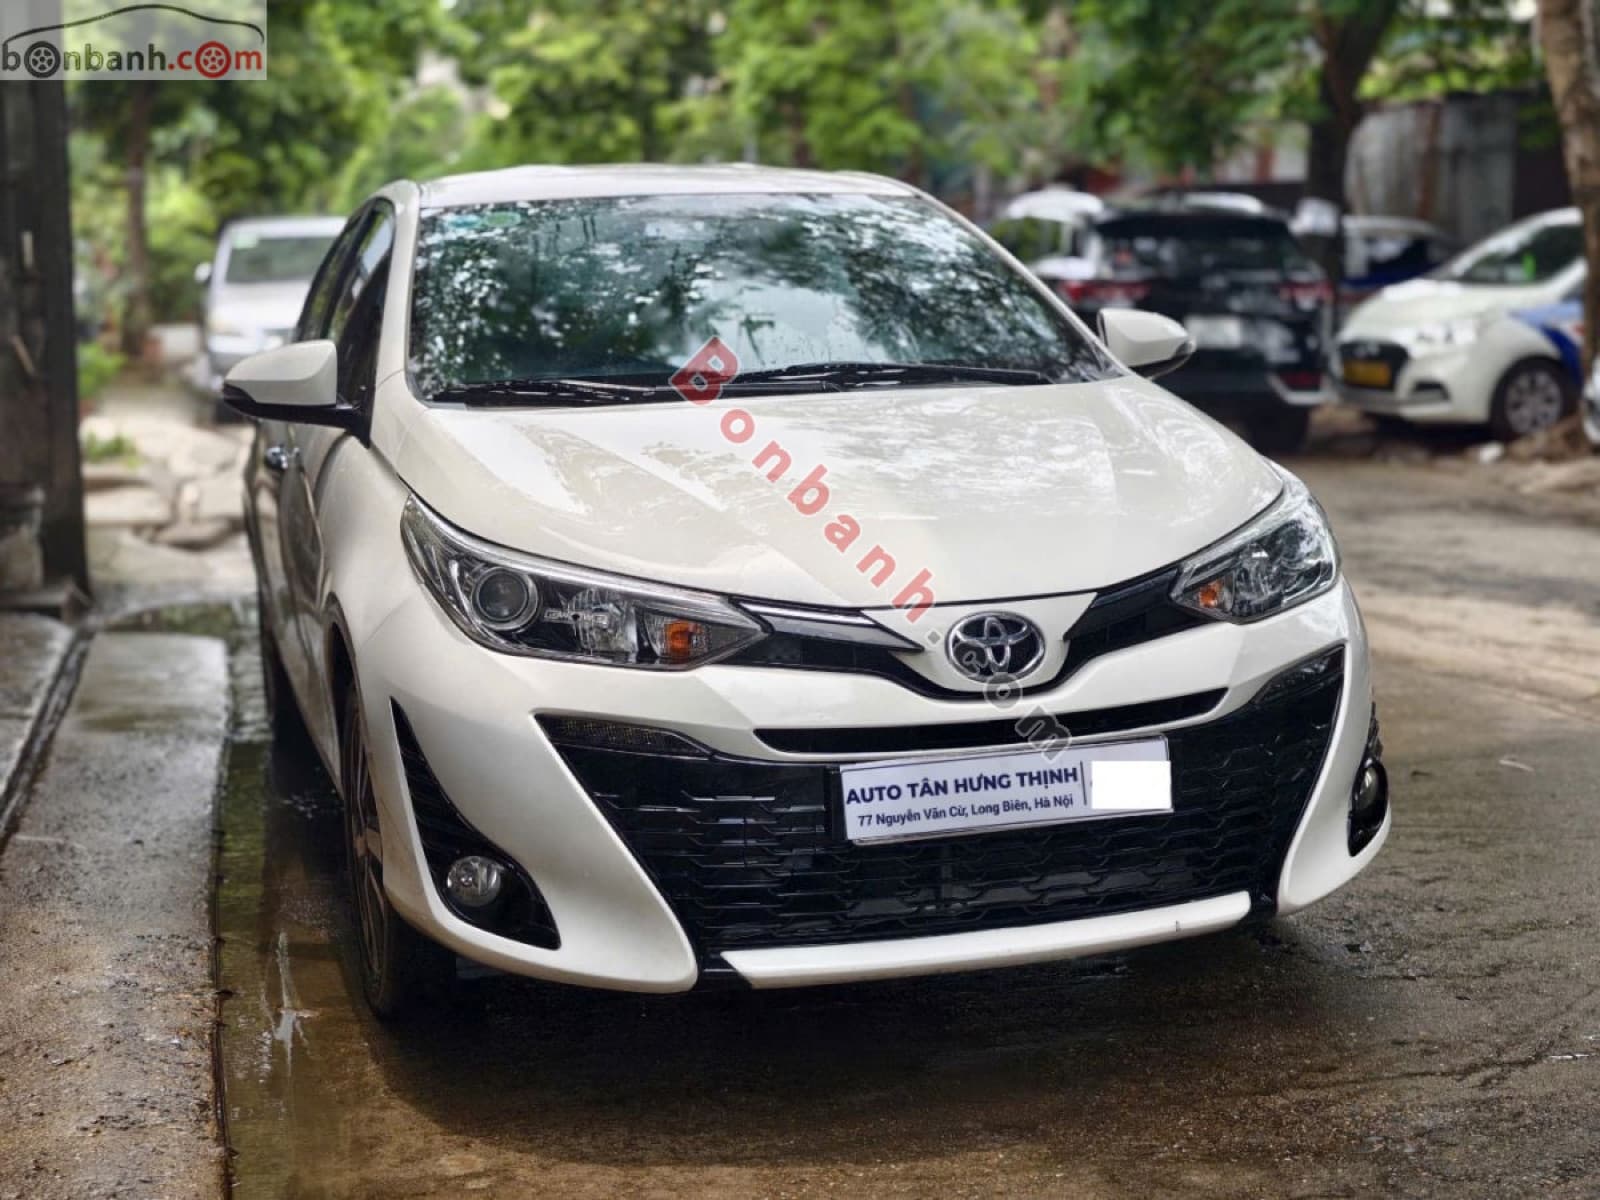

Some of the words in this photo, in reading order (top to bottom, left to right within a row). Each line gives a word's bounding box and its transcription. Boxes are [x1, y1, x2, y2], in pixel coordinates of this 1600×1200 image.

[846, 784, 902, 805] AUTO
[907, 777, 949, 798] TÂN
[954, 772, 1011, 793] HƯNG
[1015, 767, 1078, 789] THỊNH
[858, 814, 873, 827] 77
[923, 807, 947, 820] Văn
[971, 803, 1000, 816] Long
[1002, 799, 1032, 812] Biên,
[1034, 796, 1051, 809] Hà
[1053, 793, 1073, 809] Nội
